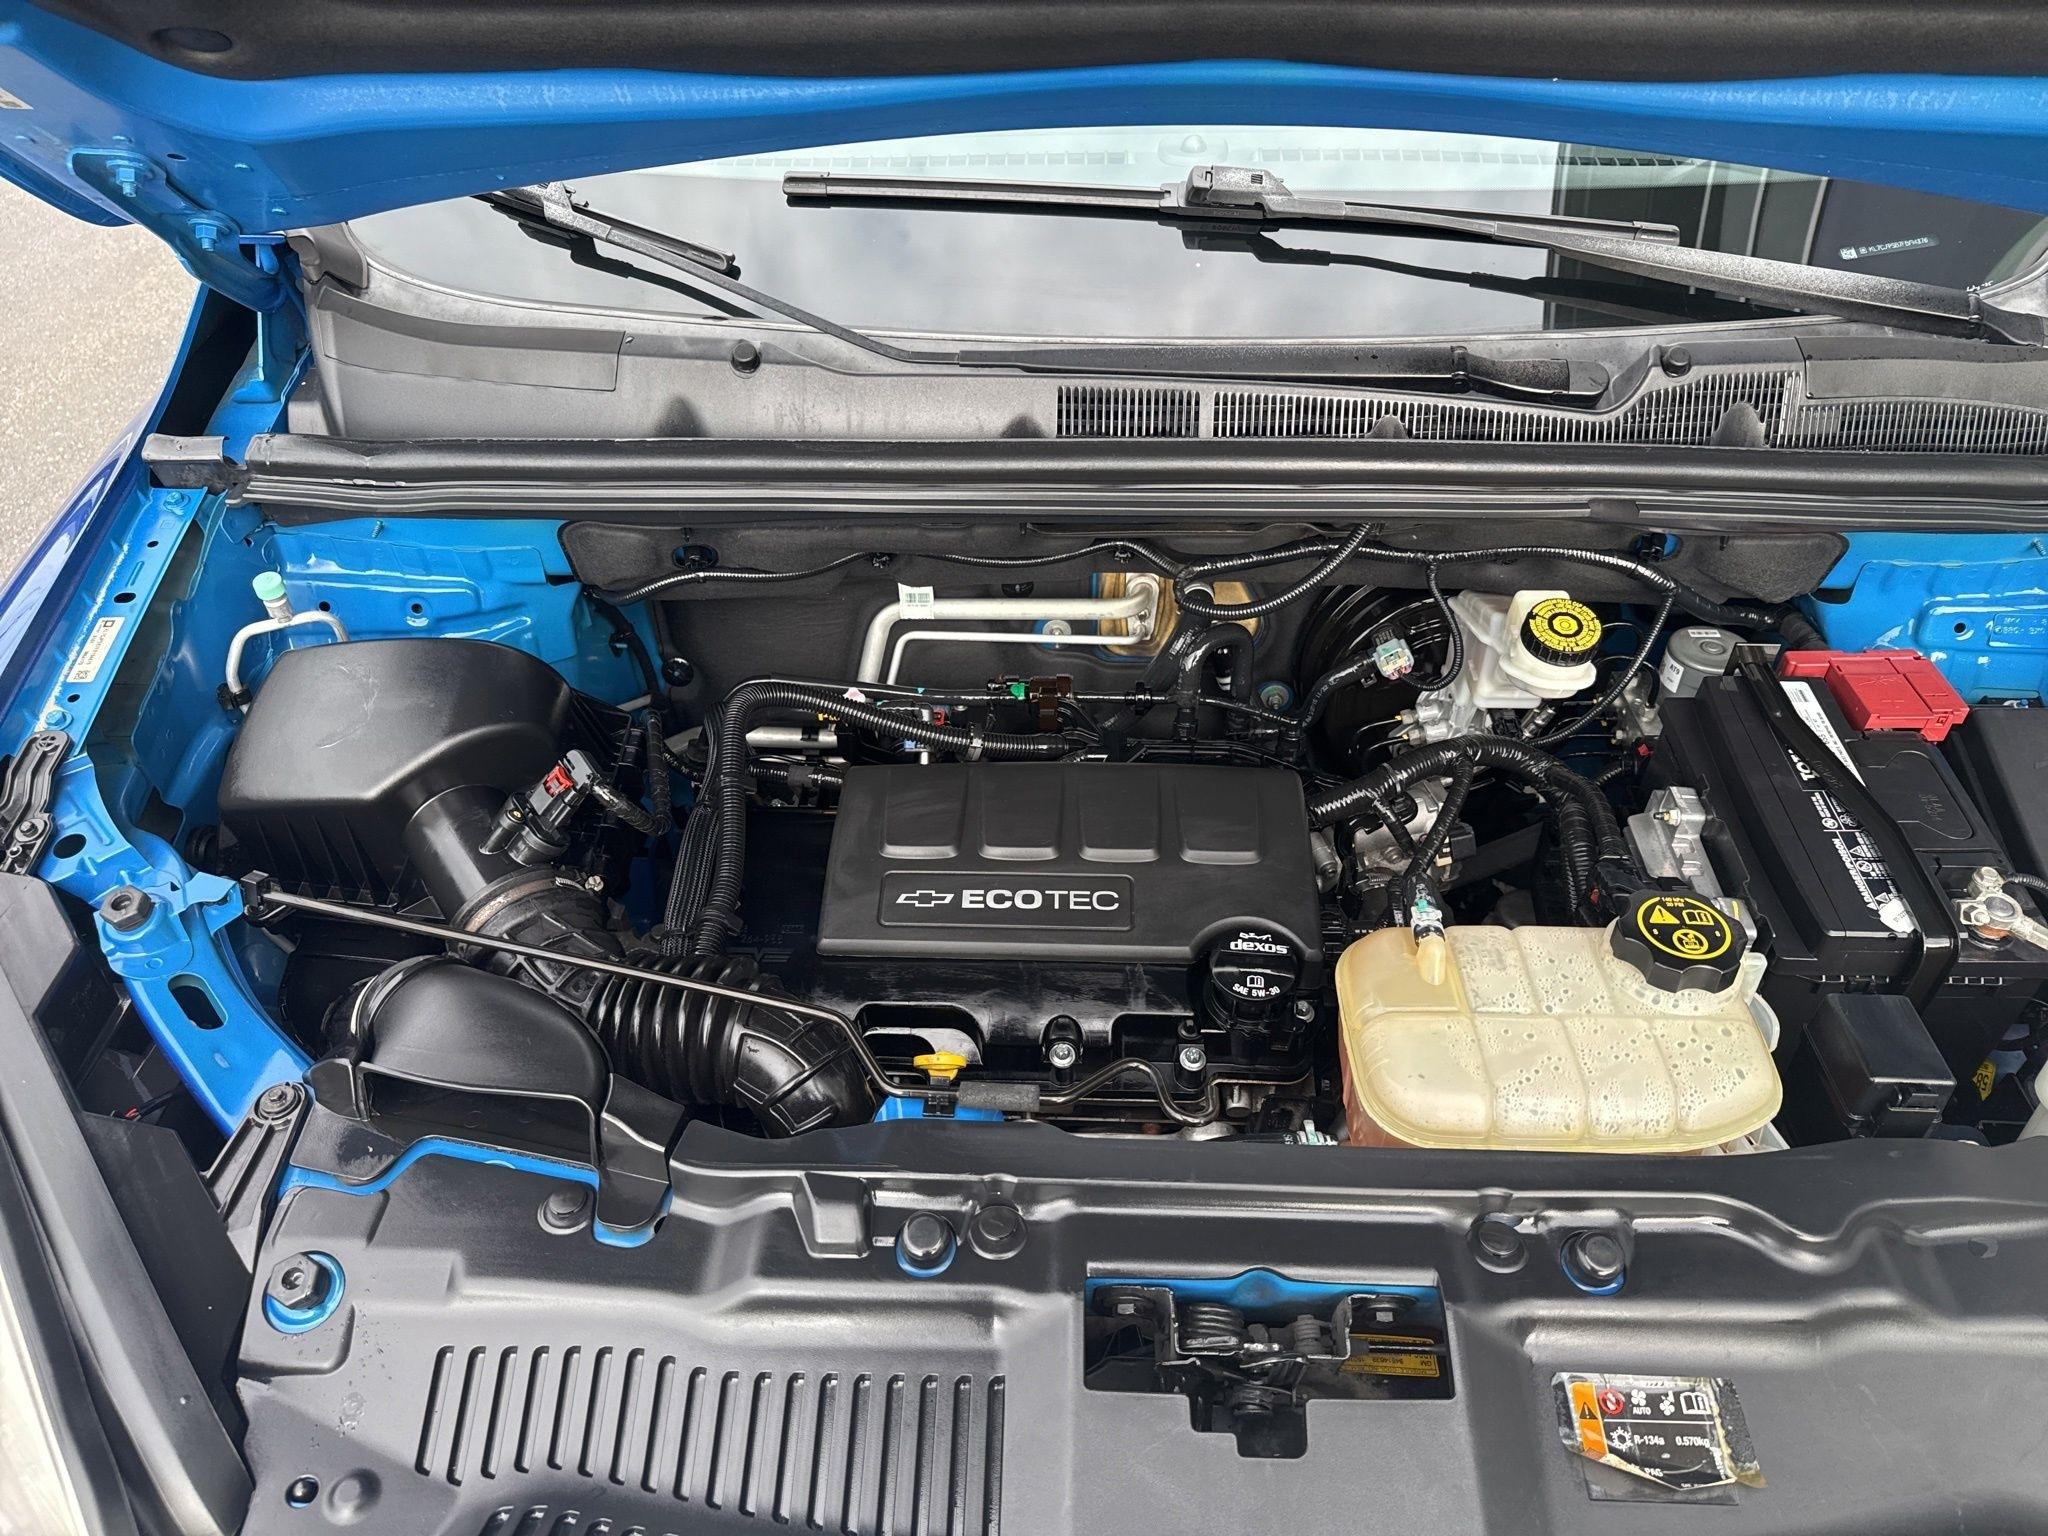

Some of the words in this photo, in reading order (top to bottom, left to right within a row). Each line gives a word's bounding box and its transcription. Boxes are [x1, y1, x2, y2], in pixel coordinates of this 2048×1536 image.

[960, 889, 1120, 911] ECOTEC
[1229, 938, 1290, 954] dexos
[1232, 983, 1250, 996] SAE
[1251, 985, 1281, 997] 5W-30
[1632, 1406, 1651, 1416] AUTO
[1633, 1434, 1666, 1446] R-134a
[1675, 1436, 1711, 1449] 0.570kg
[1644, 1467, 1664, 1478] PAG
